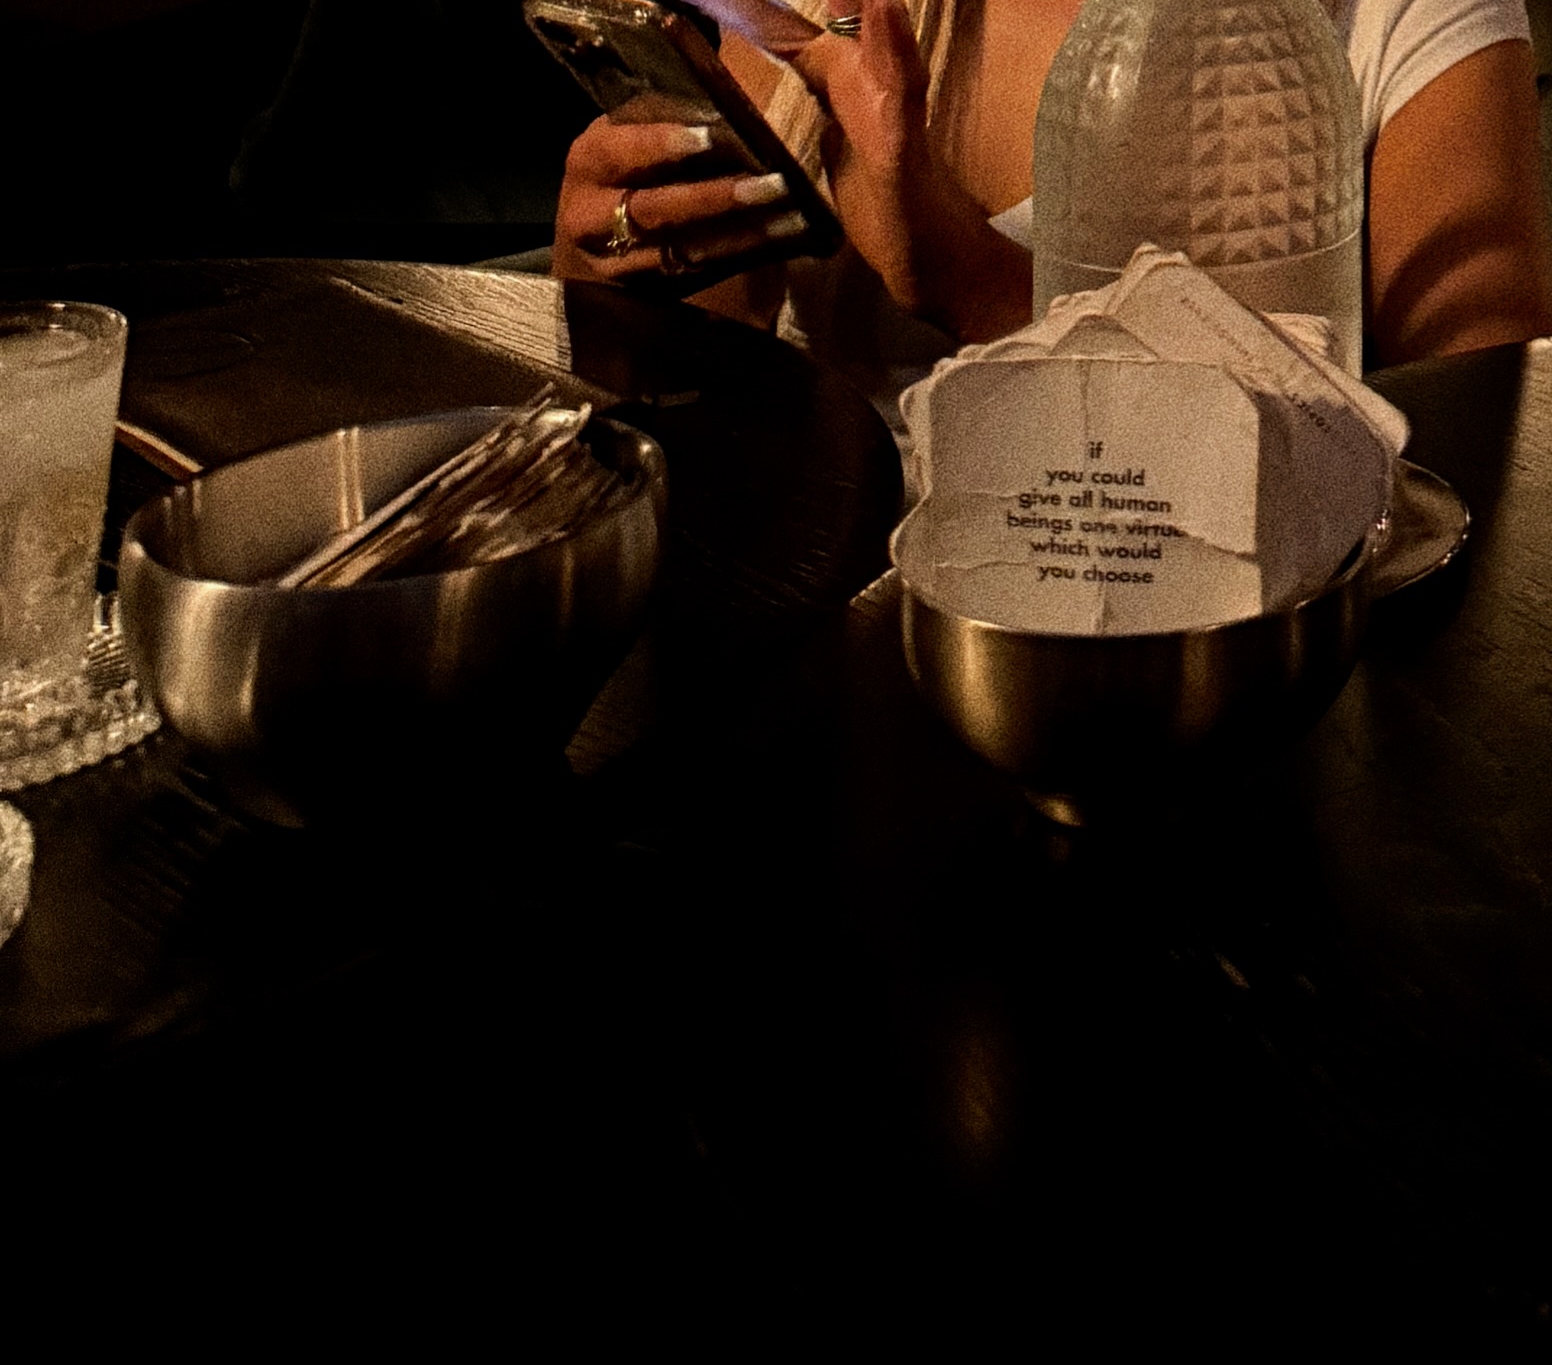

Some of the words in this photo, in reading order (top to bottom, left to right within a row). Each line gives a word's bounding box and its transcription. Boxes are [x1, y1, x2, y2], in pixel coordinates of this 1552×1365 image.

[1089, 441, 1104, 459] if
[1046, 470, 1083, 486] you
[1091, 468, 1145, 486] could
[1019, 488, 1062, 509] give
[1069, 490, 1093, 508] all
[1101, 490, 1171, 512] human
[1007, 509, 1073, 534] beings
[1080, 521, 1117, 533] one
[1031, 538, 1090, 556] which
[1098, 542, 1162, 559] would
[1038, 566, 1075, 582] you
[1083, 565, 1154, 584] choose
